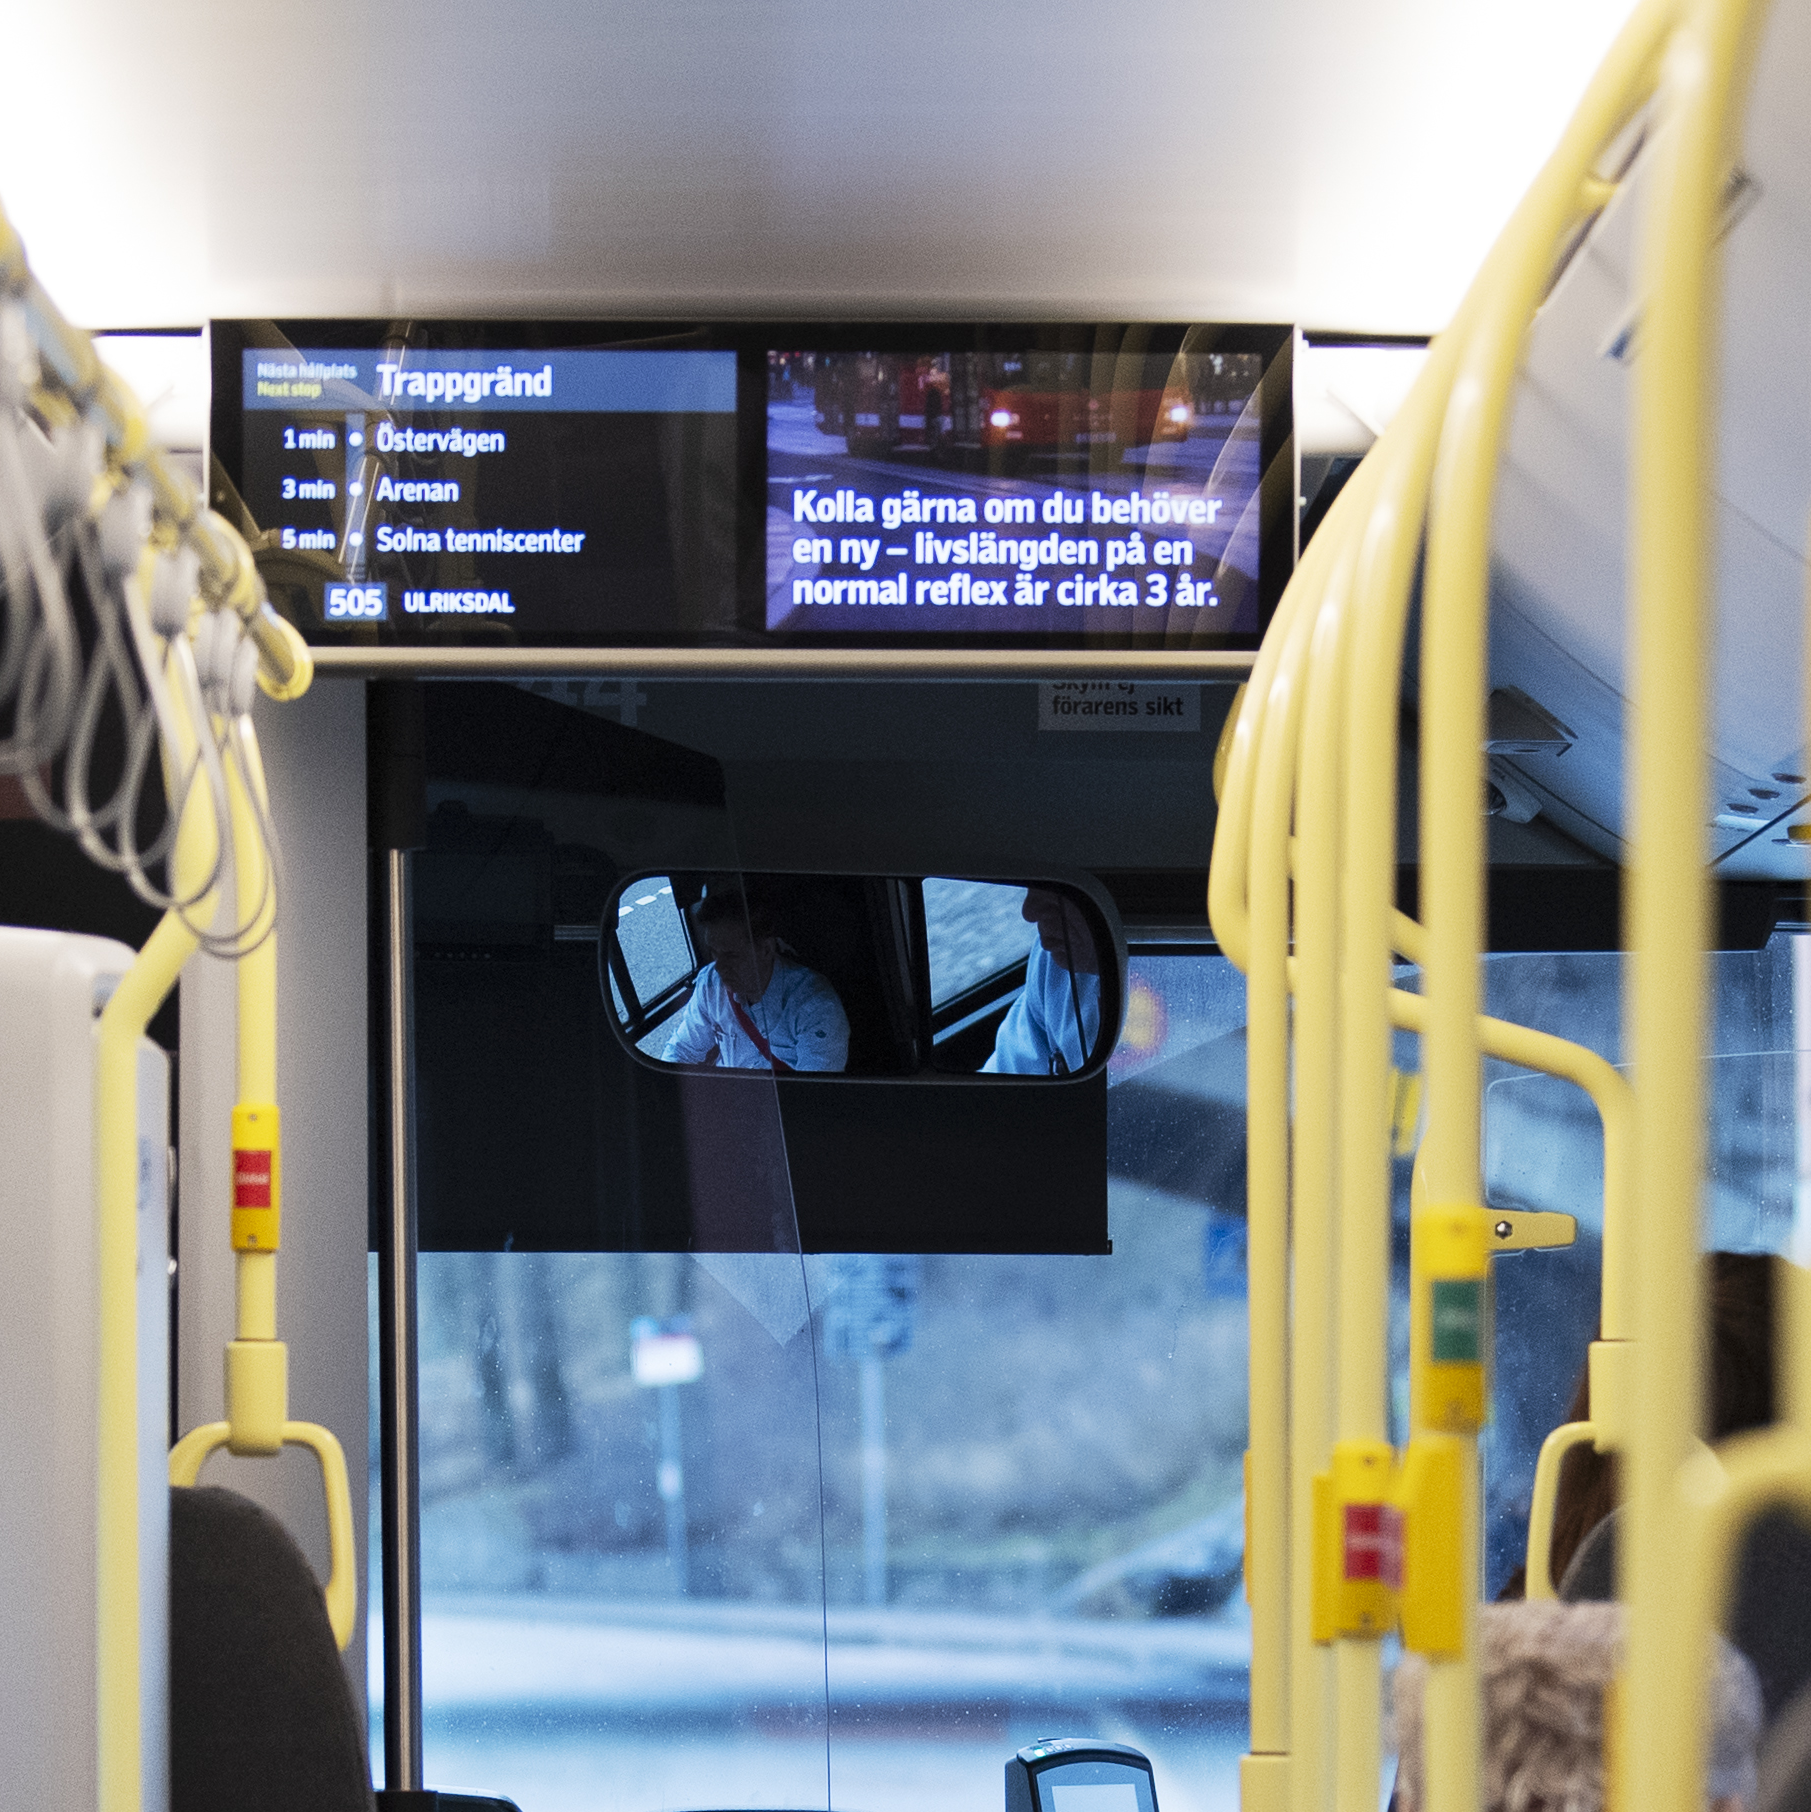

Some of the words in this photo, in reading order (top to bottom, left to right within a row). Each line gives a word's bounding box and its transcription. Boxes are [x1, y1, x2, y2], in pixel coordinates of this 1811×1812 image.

[257, 361, 297, 379] Nästa
[299, 361, 357, 381] hållplats
[257, 381, 290, 397] Next
[291, 382, 322, 399] stop
[376, 364, 552, 402] Trappgränd
[283, 429, 296, 449] 1
[298, 429, 336, 449] min
[376, 424, 505, 456] Östervägen
[282, 479, 296, 499] 3
[298, 479, 336, 499] min
[375, 479, 460, 502] Arenan
[792, 489, 875, 523] Kolla
[881, 490, 977, 529] gärna
[984, 497, 1036, 524] om
[1042, 491, 1084, 524] du
[1091, 490, 1222, 524] behöver
[281, 529, 296, 550] 5
[298, 529, 336, 550] min
[376, 526, 441, 553] Solna
[445, 527, 586, 554] tenniscenter
[792, 537, 832, 564] en
[840, 537, 880, 571] ny
[915, 532, 1099, 571] livslängden
[1106, 532, 1147, 572] på
[1153, 536, 1194, 564] en
[792, 573, 908, 606] normal
[915, 573, 1009, 606] reflex
[1014, 573, 1050, 606] är
[1057, 573, 1139, 606] cirka
[1146, 573, 1168, 607] 3
[1175, 573, 1220, 607] år.
[329, 588, 383, 617] 505
[403, 592, 516, 613] ULRIKSDAL
[1052, 695, 1138, 716] förarens
[1145, 696, 1184, 716] sikt
